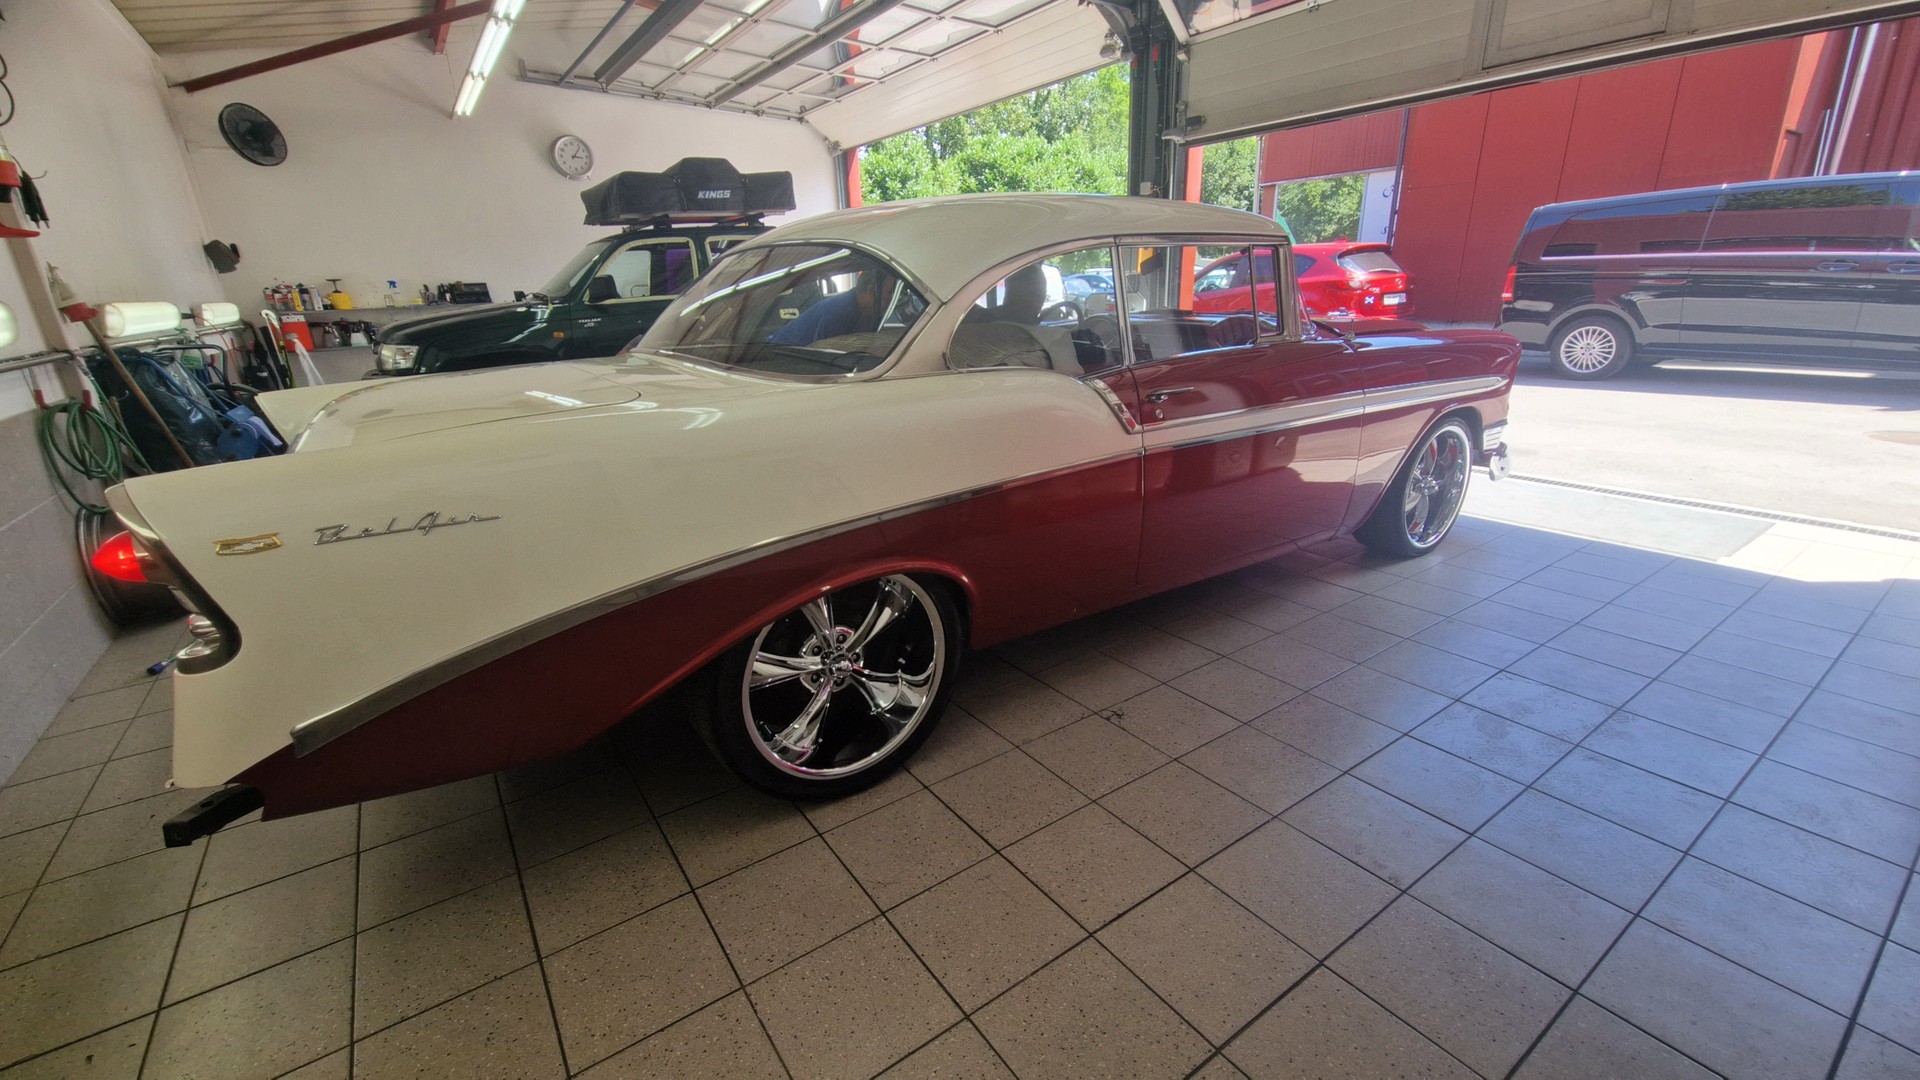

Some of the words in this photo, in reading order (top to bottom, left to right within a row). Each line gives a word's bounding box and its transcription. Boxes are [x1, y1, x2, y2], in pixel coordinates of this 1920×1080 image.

[697, 190, 731, 199] KINGS
[313, 515, 398, 545] Bel
[408, 510, 502, 536] Air
